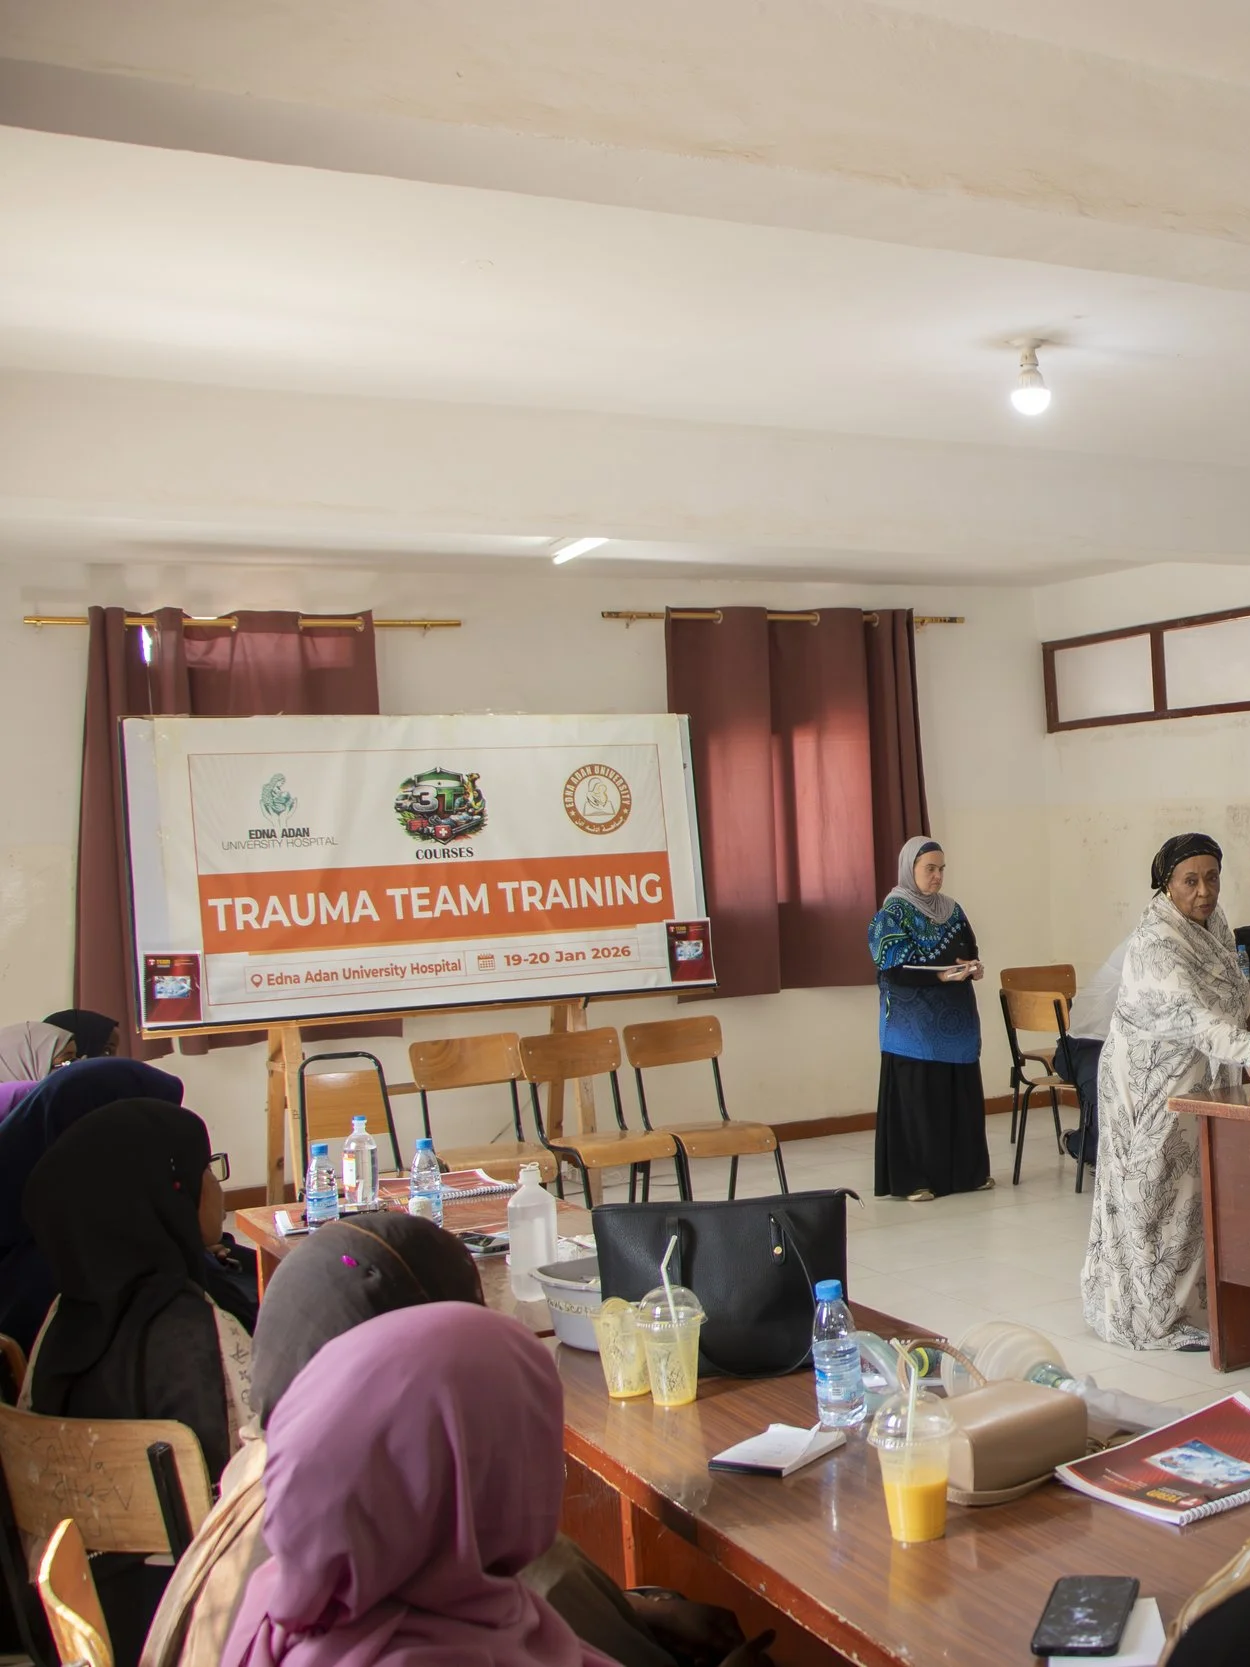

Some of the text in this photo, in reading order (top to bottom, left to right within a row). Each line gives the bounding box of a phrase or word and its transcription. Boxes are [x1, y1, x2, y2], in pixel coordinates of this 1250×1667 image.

[411, 785, 465, 812] 3T
[564, 766, 631, 808] EDNA ADAN UNIVERSITY
[222, 836, 338, 850] UNIVERSITY HOSPITAL
[248, 828, 310, 840] EDNA ADAN
[416, 847, 474, 860] COURSES
[208, 872, 663, 932] TRAUMA TEAM TRAINING
[504, 946, 632, 966] 19-20 Jan 2026
[267, 959, 462, 986] Edna Adan University Hospital
